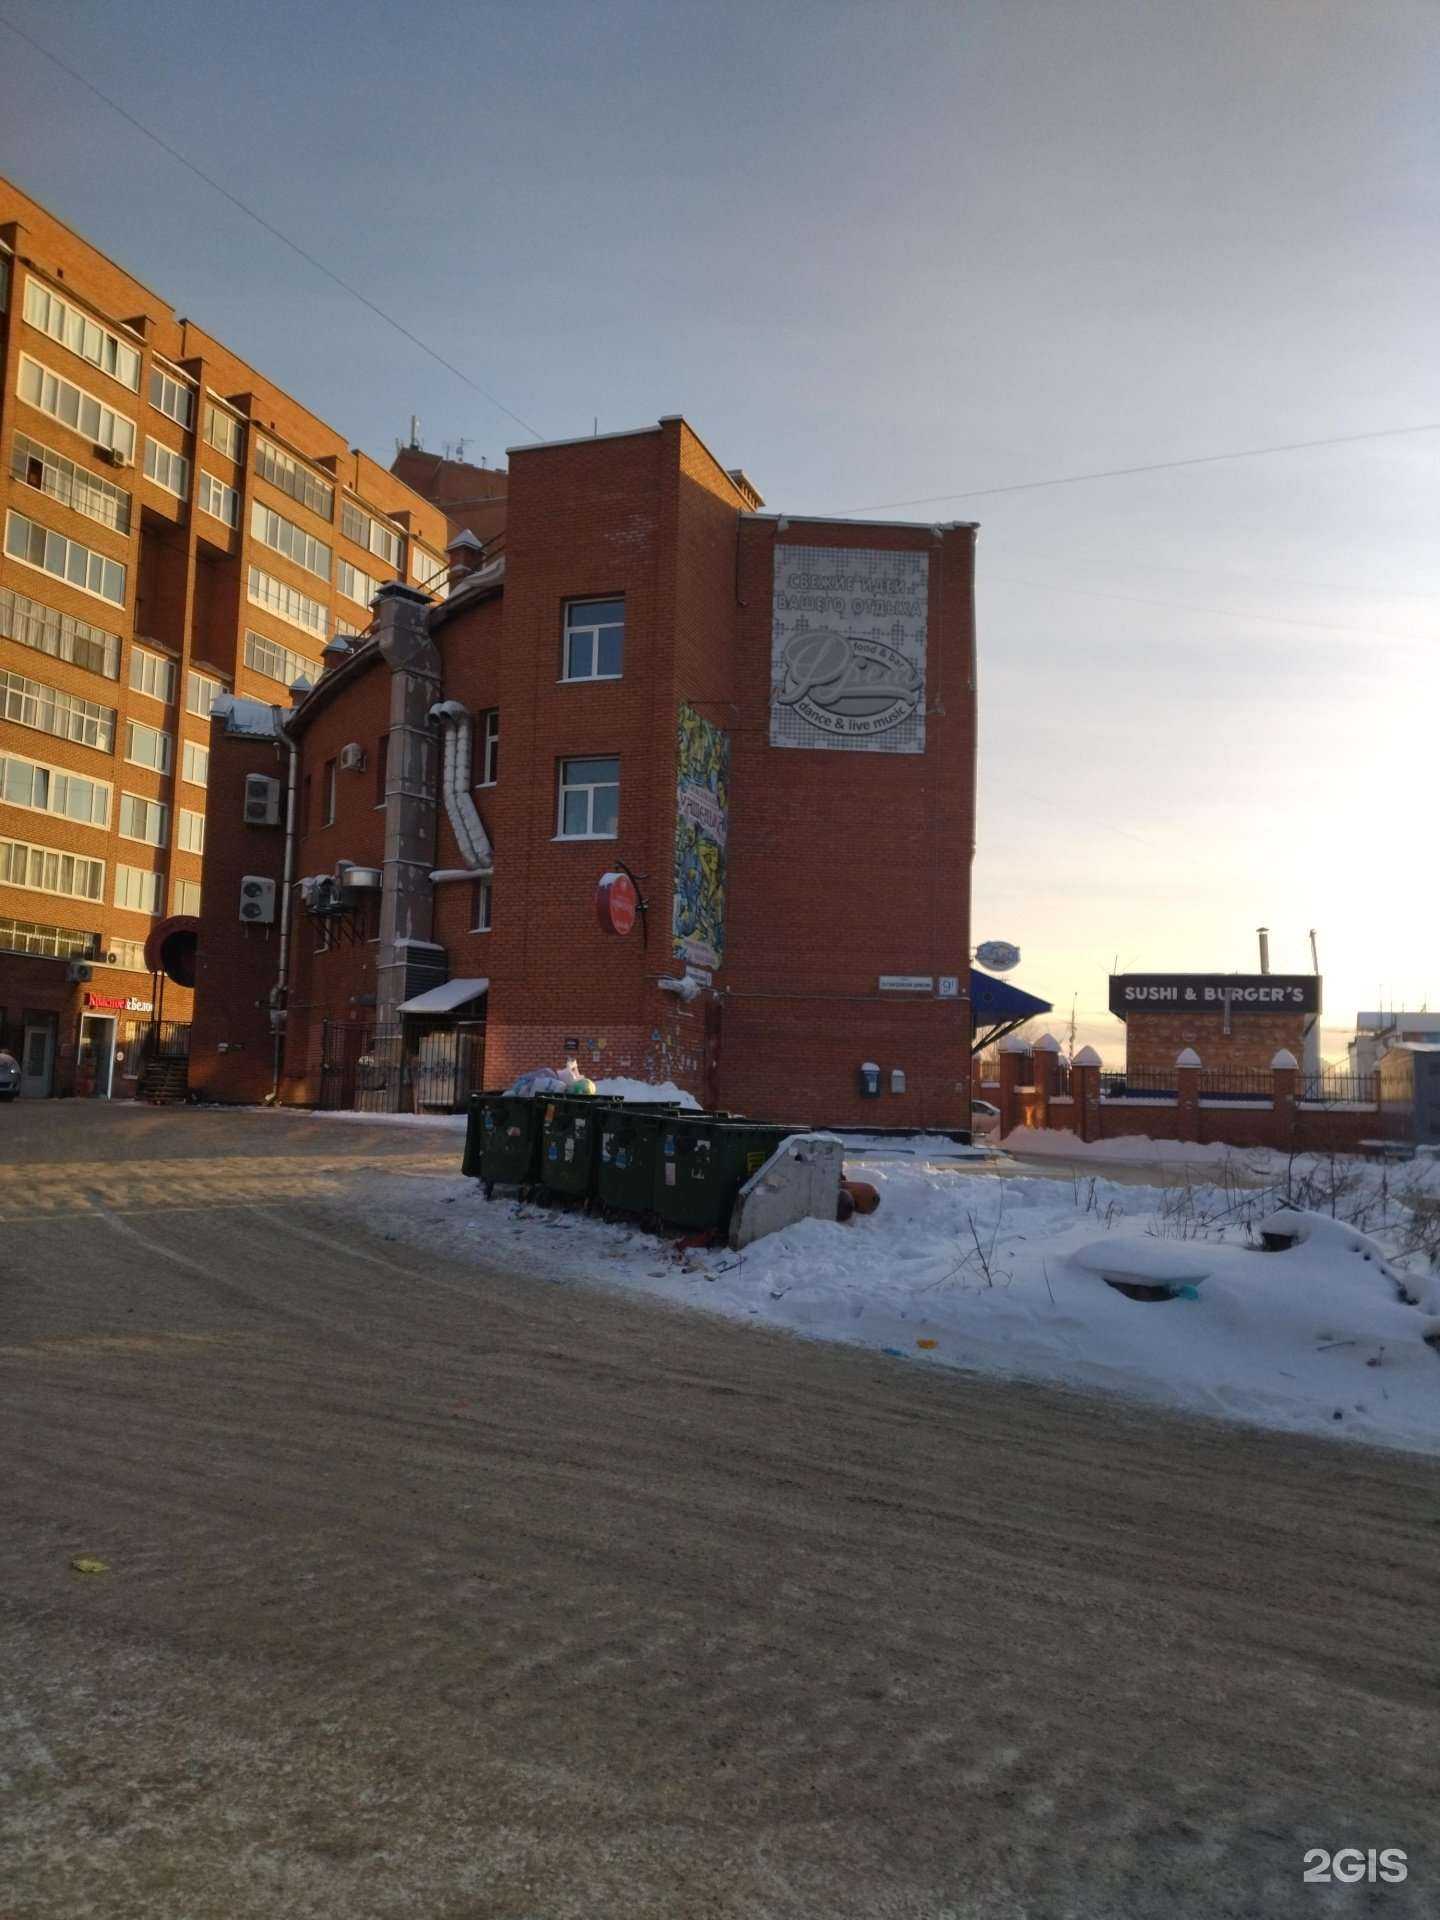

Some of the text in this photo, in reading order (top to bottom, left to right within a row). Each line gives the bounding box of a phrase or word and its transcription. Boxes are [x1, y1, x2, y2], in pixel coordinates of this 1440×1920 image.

[879, 648, 888, 658] &
[798, 702, 906, 731] dance & live music
[1124, 987, 1178, 1000] SUSHI
[1184, 987, 1197, 1001] &
